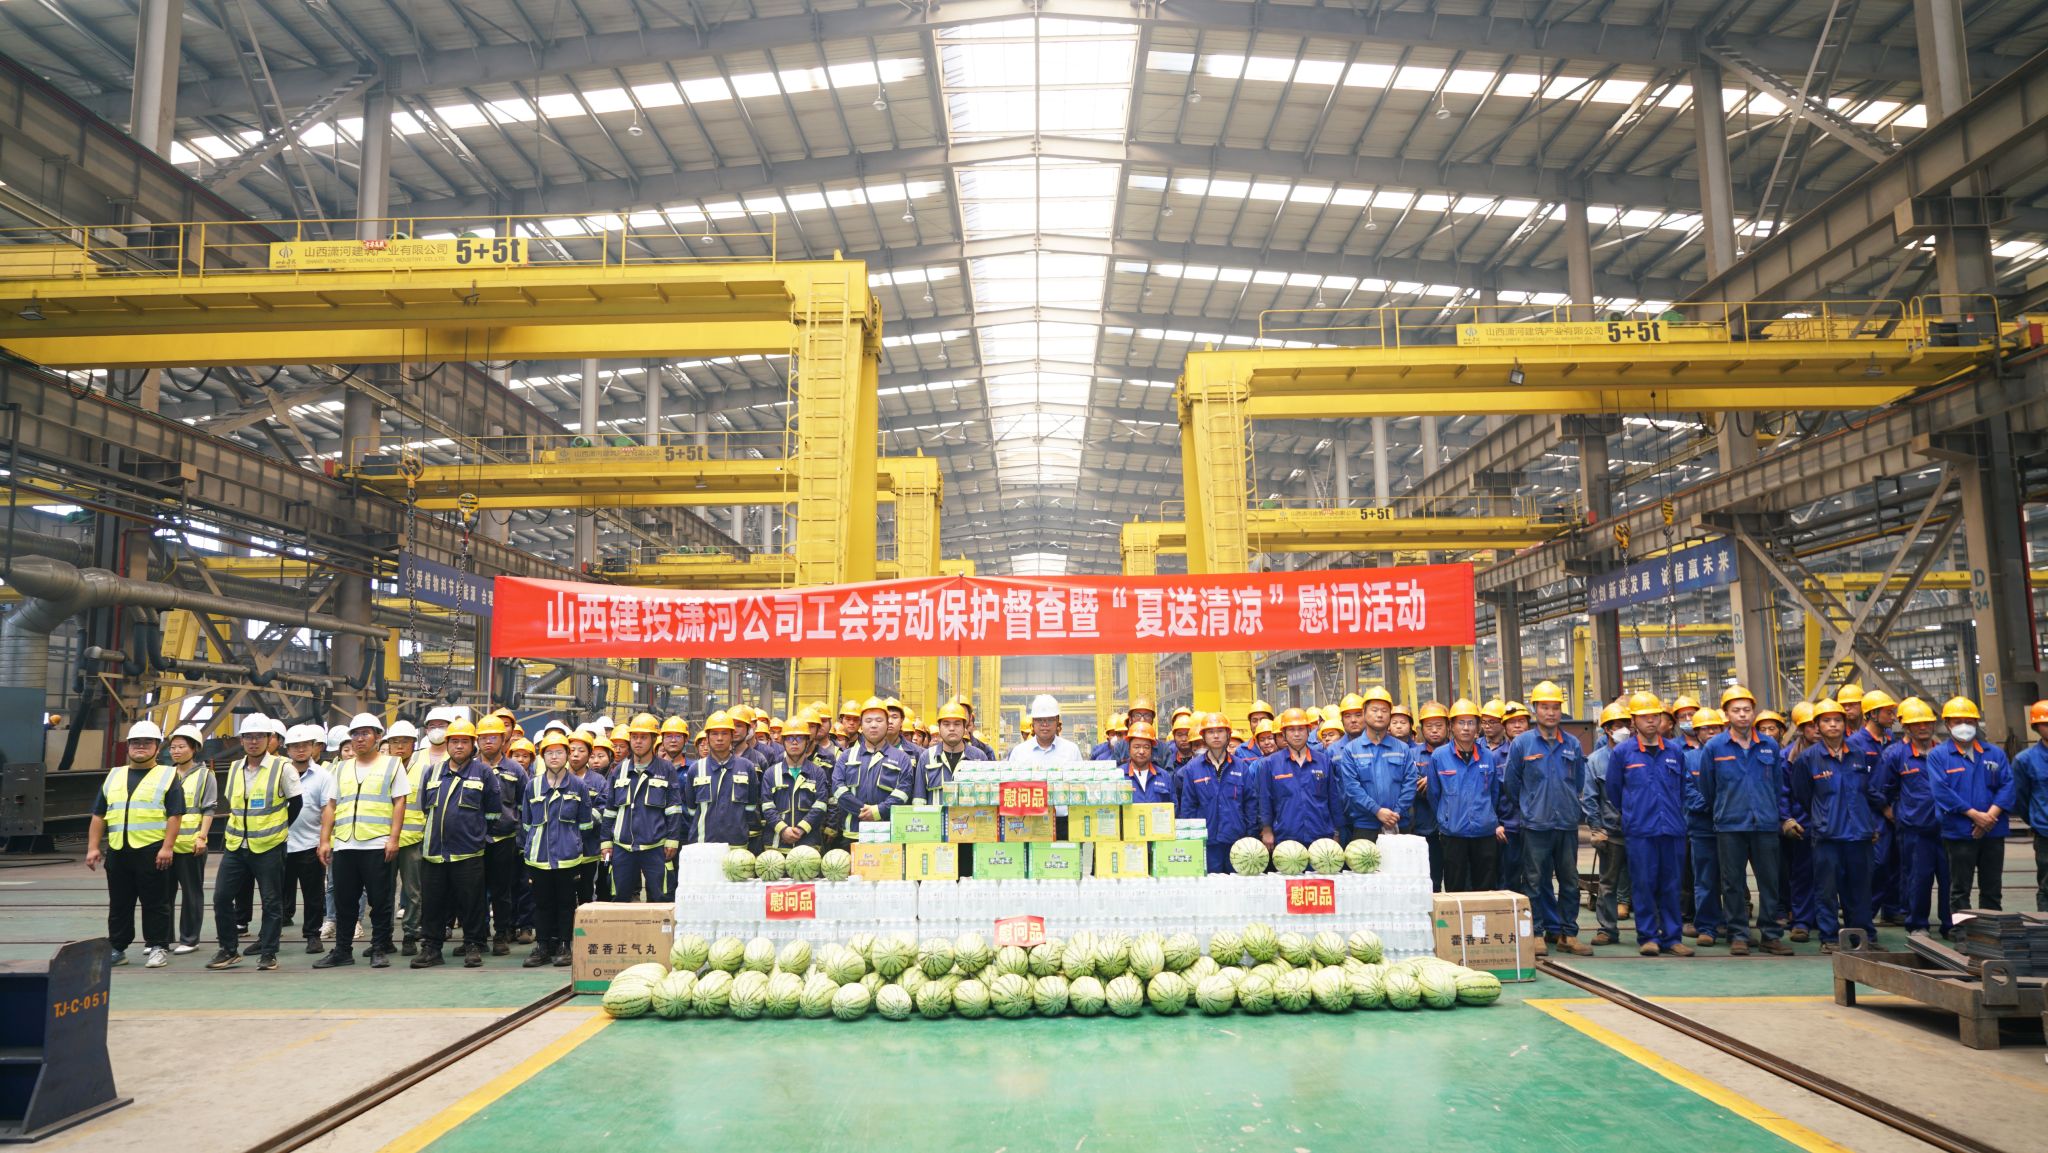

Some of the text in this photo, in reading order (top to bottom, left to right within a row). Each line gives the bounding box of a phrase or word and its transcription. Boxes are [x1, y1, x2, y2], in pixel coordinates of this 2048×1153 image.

[456, 239, 520, 265] 5+5t
[1607, 321, 1661, 343] 5+5t
[665, 446, 703, 462] 5+5t
[1360, 508, 1390, 520] 5+5t
[1598, 549, 1730, 602] 创新谋发展 诚信赢未来
[1974, 569, 1986, 587] D
[1974, 590, 1990, 611] 34
[1734, 613, 1741, 626] D
[1003, 787, 1045, 808] 慰问品
[770, 891, 813, 912] 慰问品
[1290, 885, 1333, 906] 慰问品
[999, 924, 1044, 943] 慰问品
[587, 943, 657, 955] 藿香正气丸
[53, 991, 109, 1018] TJ-C-051
